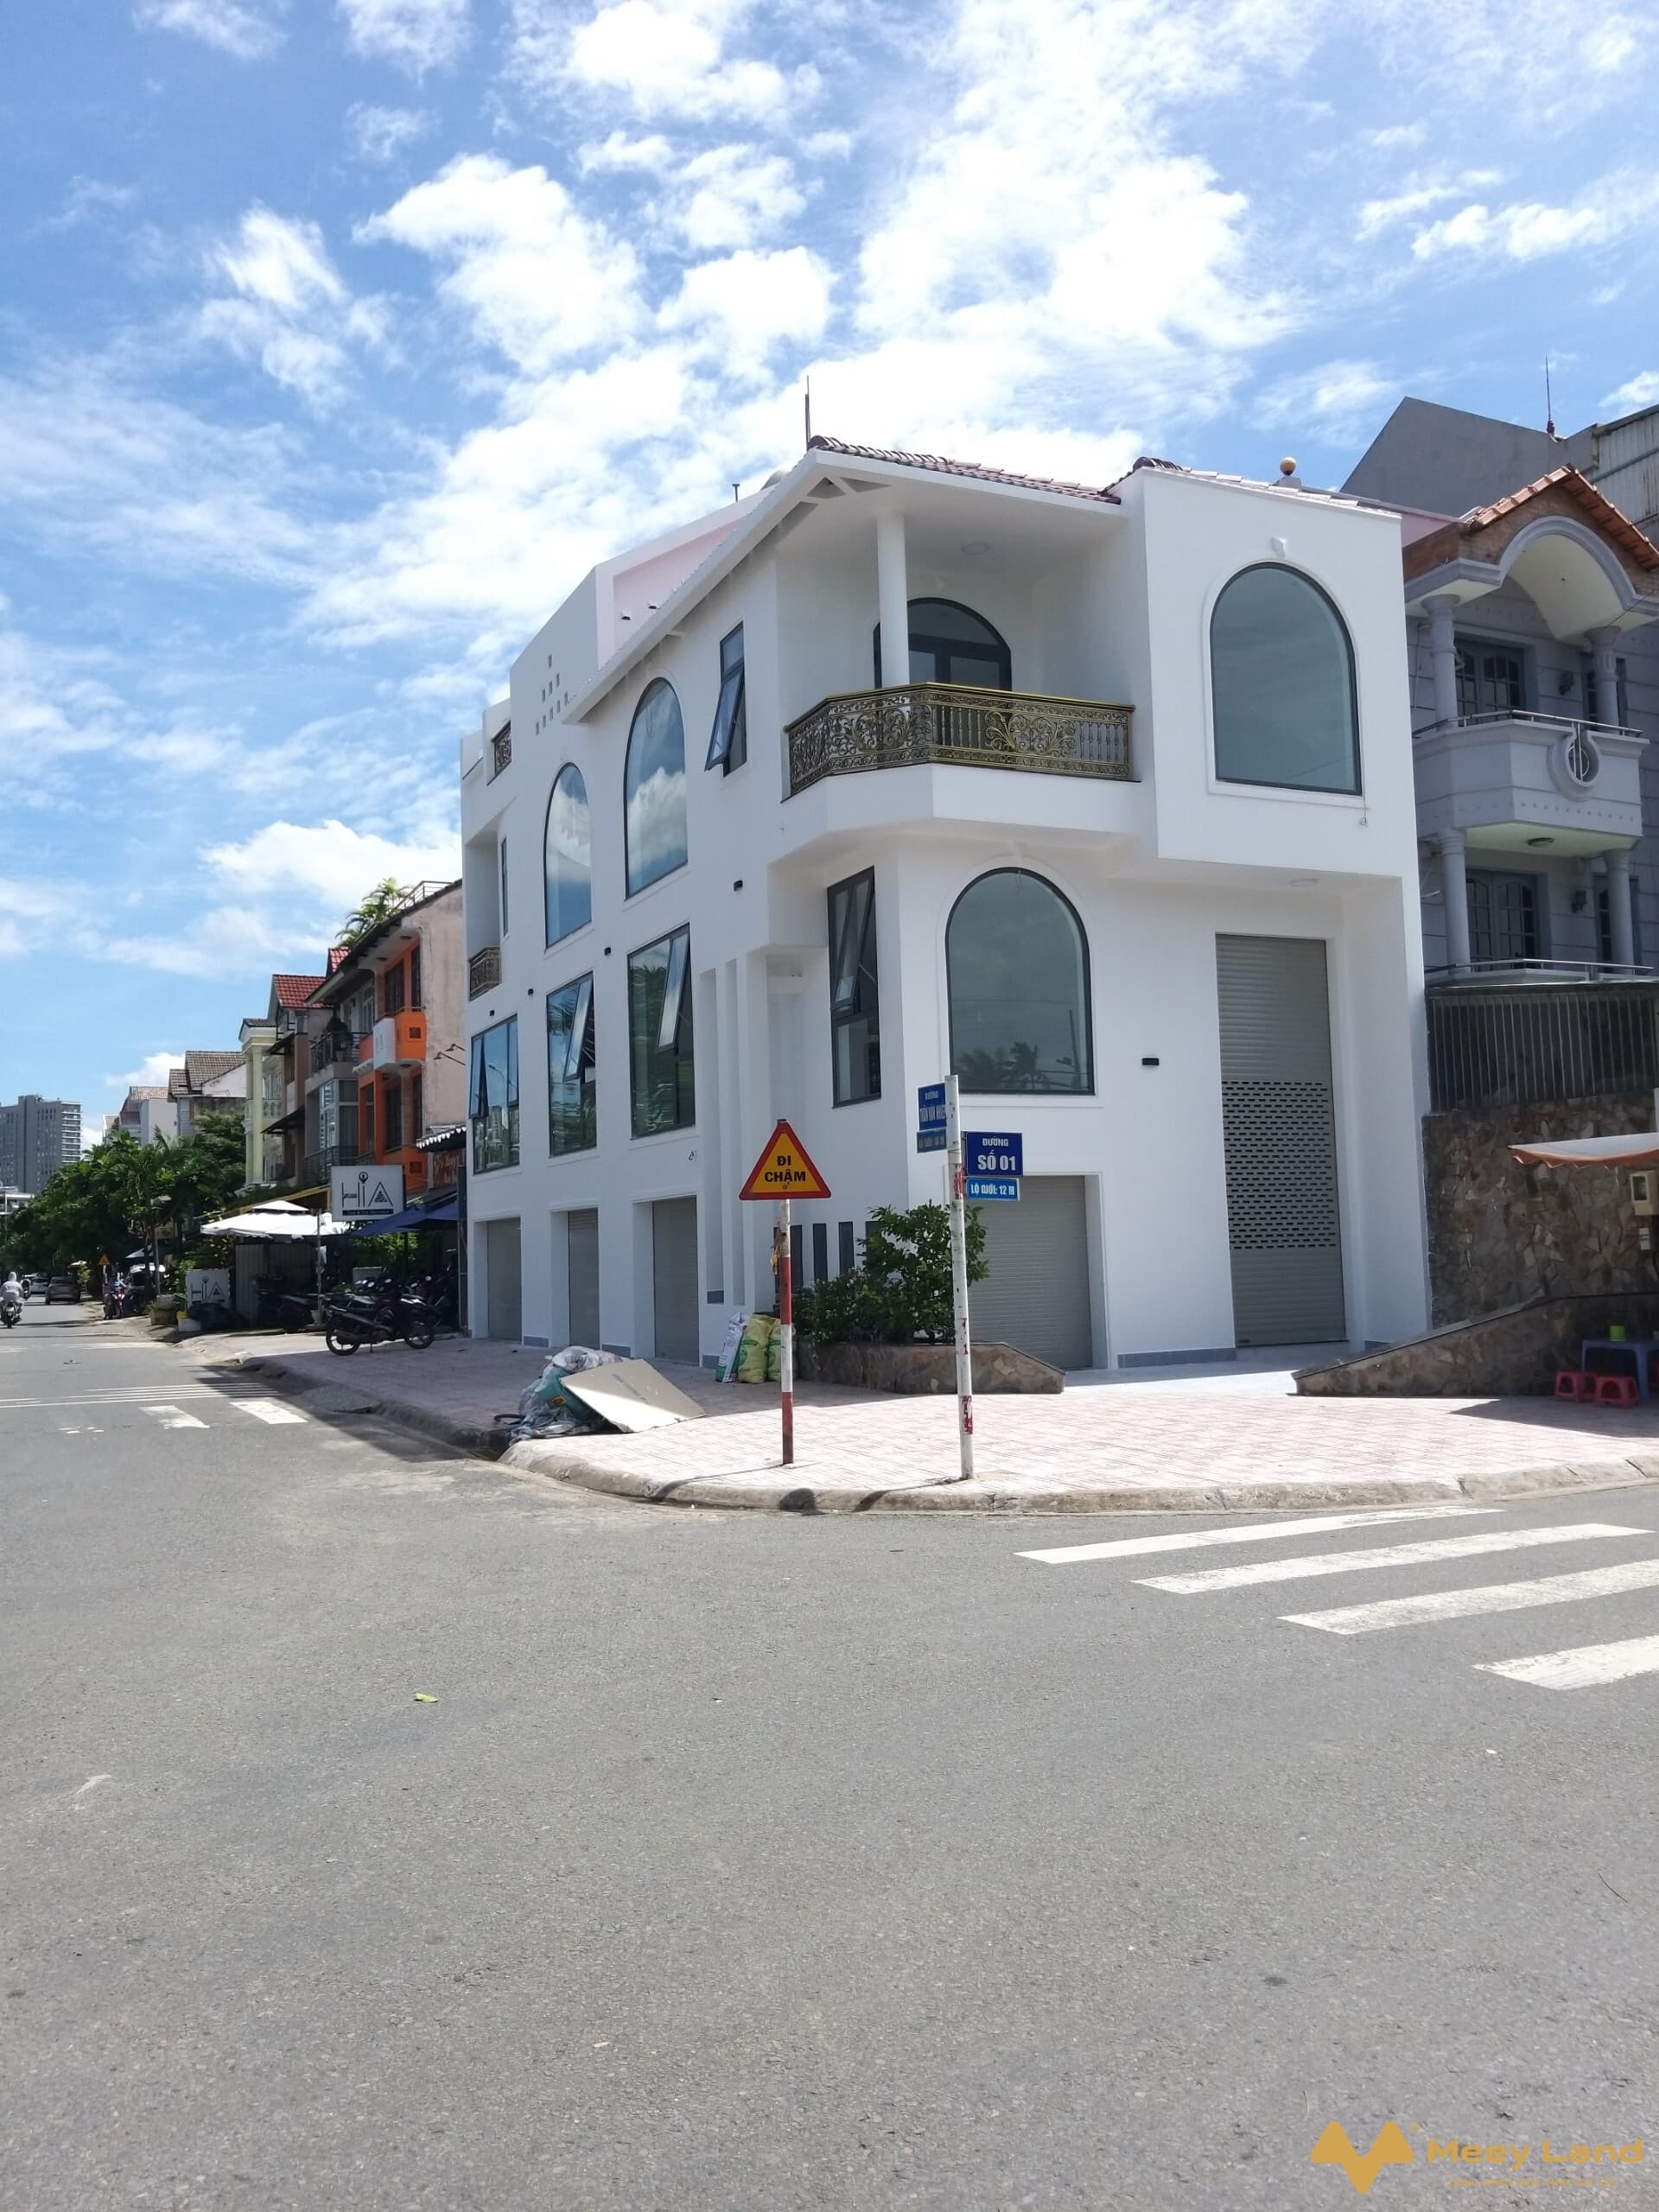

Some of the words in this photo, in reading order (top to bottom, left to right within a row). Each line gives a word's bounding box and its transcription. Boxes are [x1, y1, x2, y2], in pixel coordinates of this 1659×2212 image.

[982, 1135, 1009, 1147] ĐƯỜNG
[777, 1155, 792, 1166] ĐI
[977, 1149, 996, 1171] SỐ
[999, 1154, 1016, 1172] 01
[764, 1169, 806, 1185] CHẬM
[970, 1182, 980, 1196] LỘ
[998, 1185, 1007, 1196] 12
